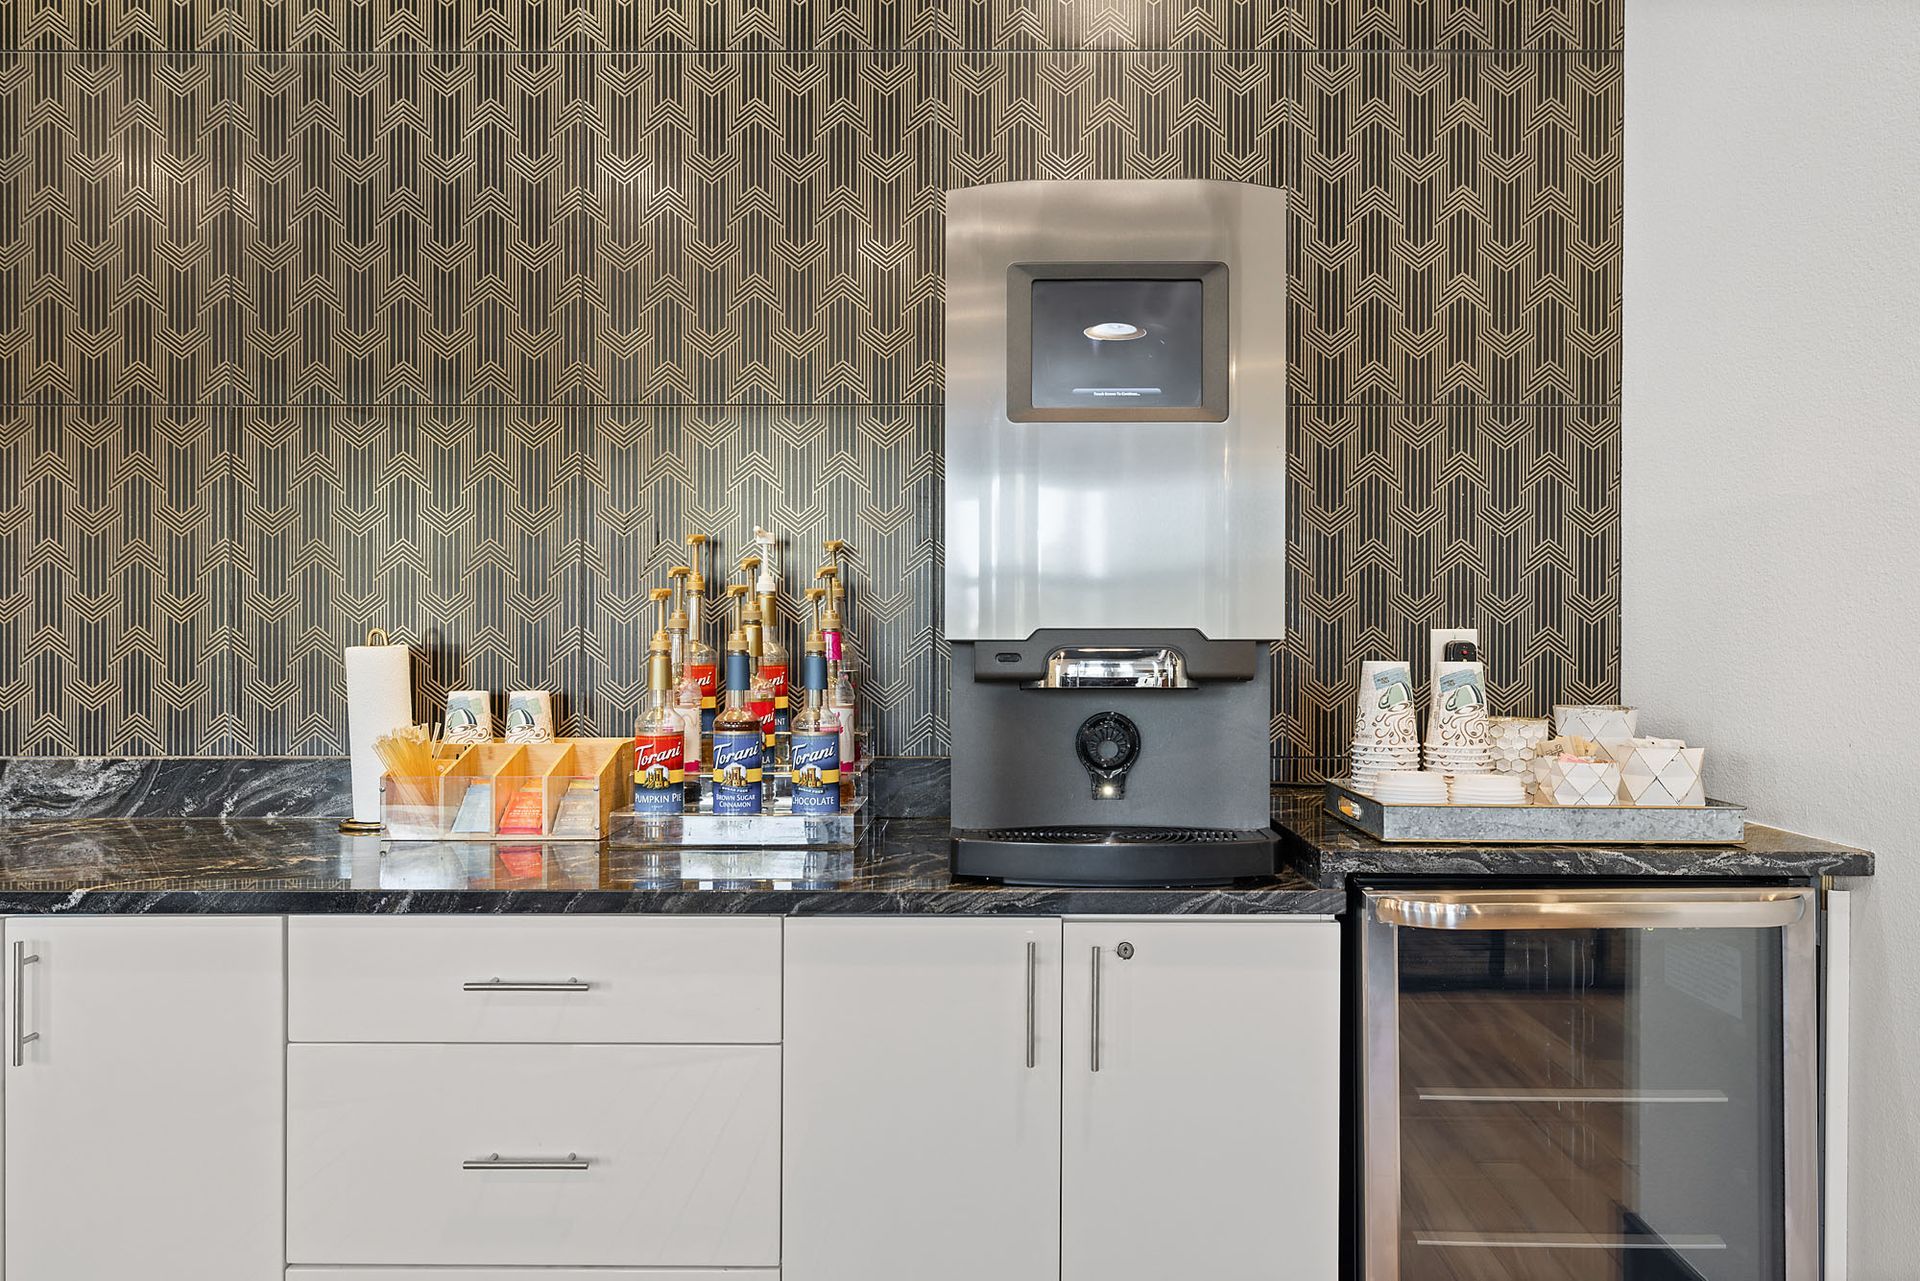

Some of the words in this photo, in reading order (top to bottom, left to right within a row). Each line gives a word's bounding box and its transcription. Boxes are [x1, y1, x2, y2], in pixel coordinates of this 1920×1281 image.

[635, 741, 682, 772] Torani
[713, 740, 760, 771] Torani
[791, 741, 835, 771] Torani
[634, 792, 670, 804] PUMPKIN
[671, 792, 682, 803] PIE
[715, 793, 736, 802] BROWN
[736, 793, 756, 802] SUGAR
[719, 800, 752, 809] CINNAMON
